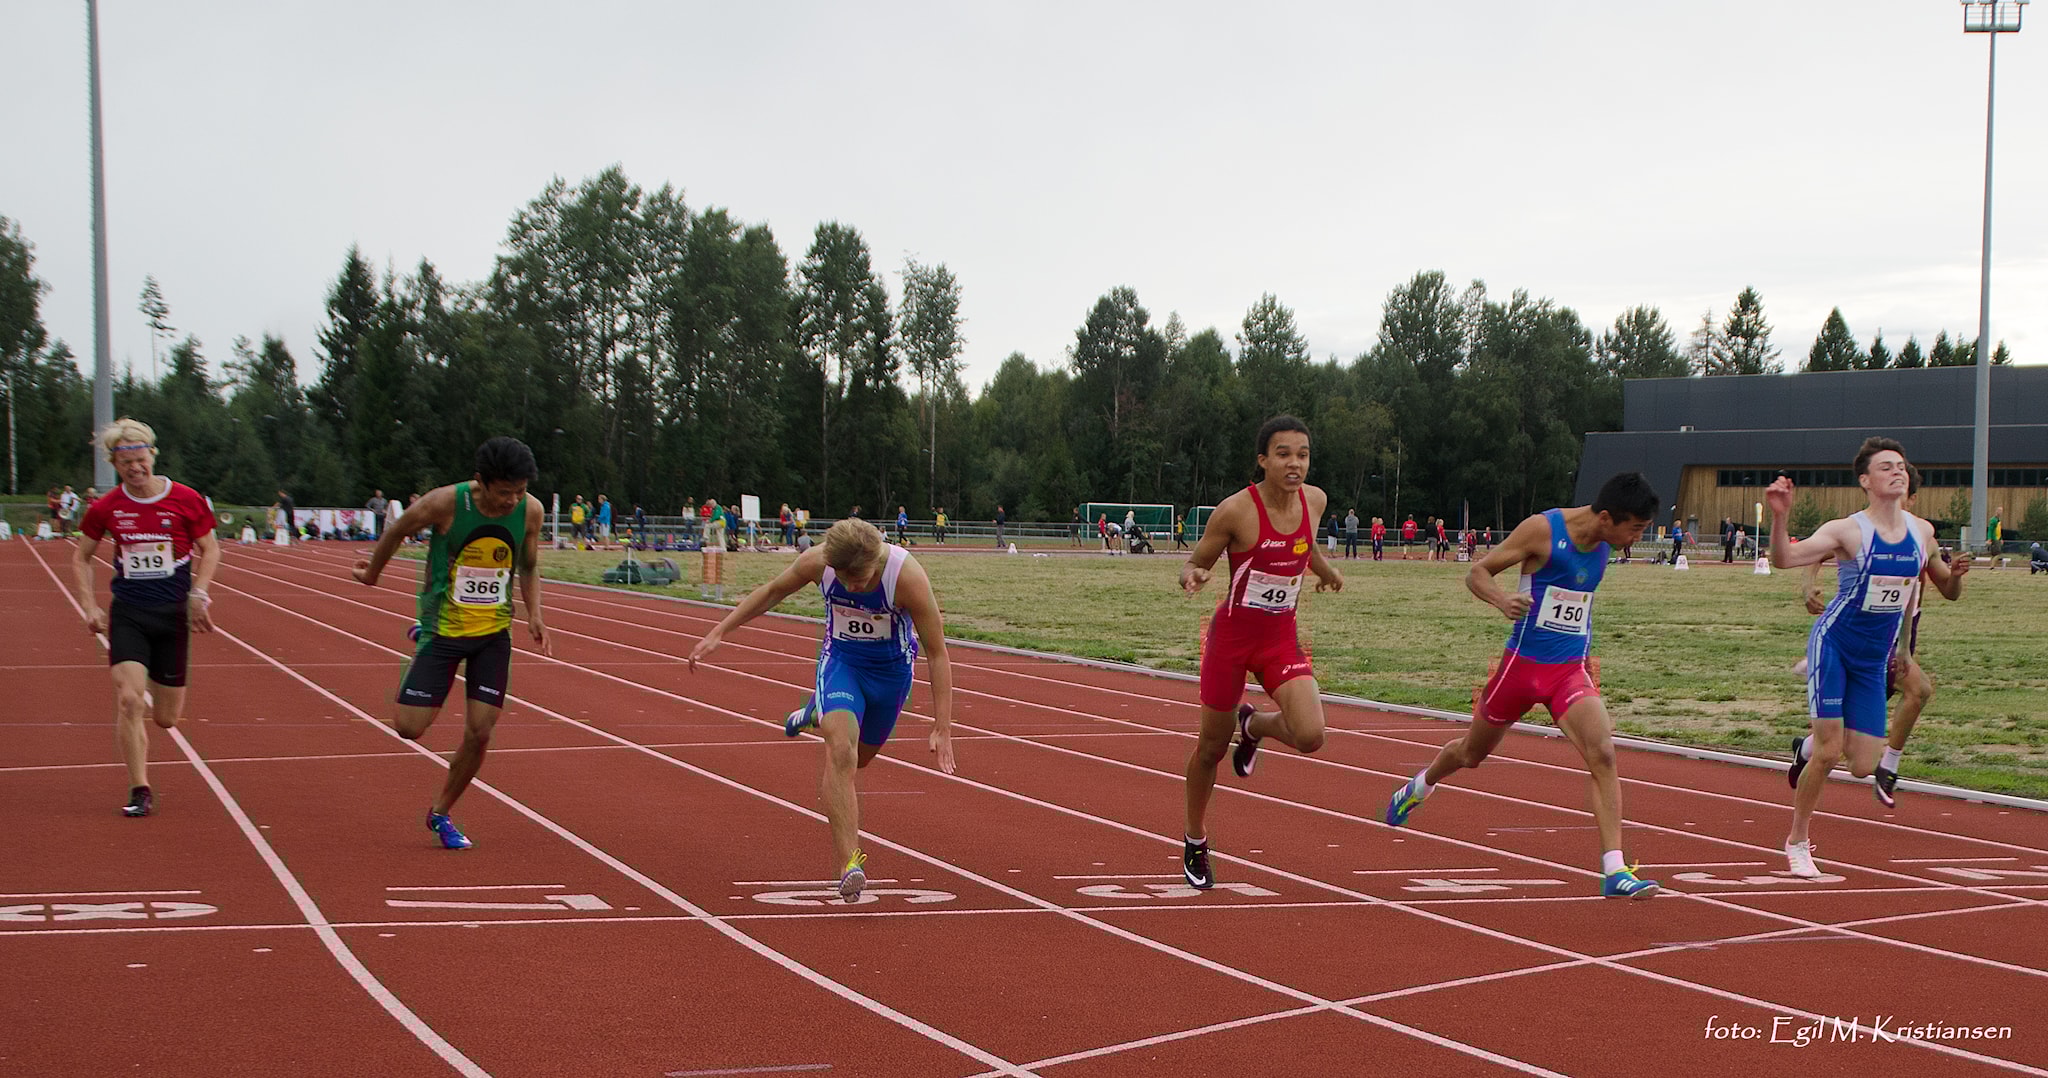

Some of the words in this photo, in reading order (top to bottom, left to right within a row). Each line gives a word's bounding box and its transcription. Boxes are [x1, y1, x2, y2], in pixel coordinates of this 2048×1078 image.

[130, 555, 164, 569] 319
[465, 581, 500, 595] 366
[1262, 589, 1287, 604] 49
[1882, 590, 1900, 603] 79
[1552, 603, 1583, 622] 150
[848, 620, 874, 634] 80
[1401, 878, 1569, 893] 4
[1672, 870, 1847, 886] 3
[751, 888, 957, 906] 6
[1075, 883, 1282, 899] 5
[386, 893, 613, 911] 7
[0, 901, 218, 922] 8
